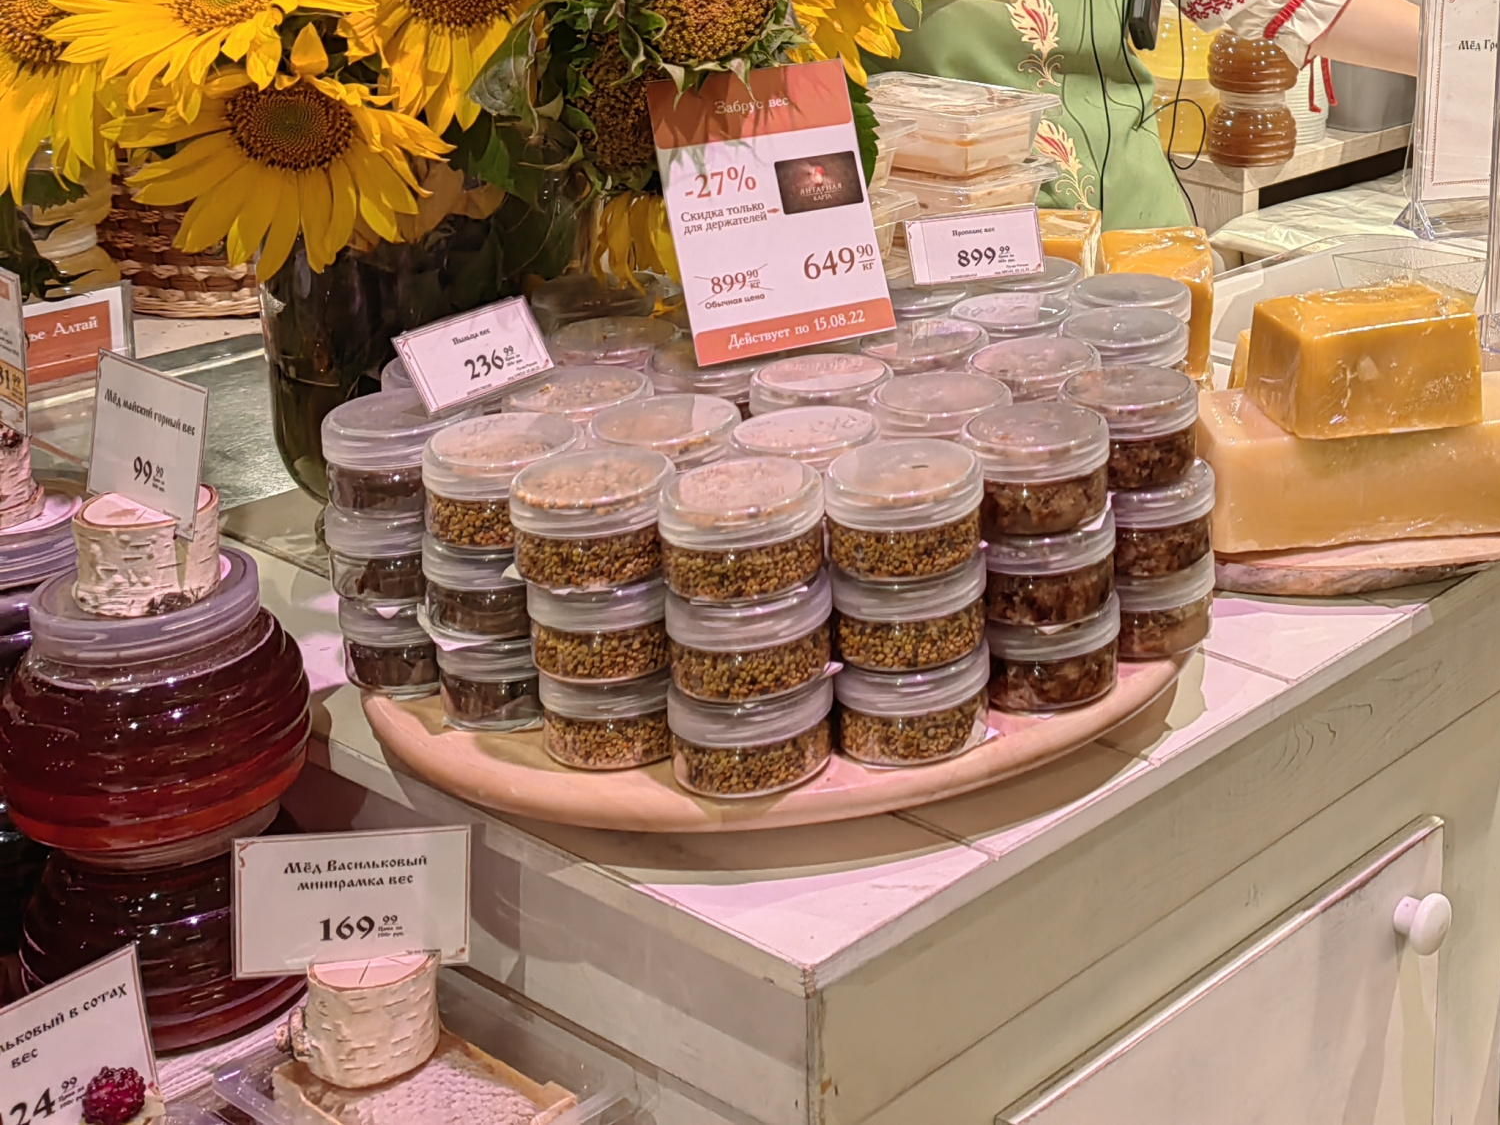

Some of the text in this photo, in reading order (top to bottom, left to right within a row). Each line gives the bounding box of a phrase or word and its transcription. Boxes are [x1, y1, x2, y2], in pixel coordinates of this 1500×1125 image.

[1458, 40, 1481, 51] Мёд
[714, 96, 789, 115] Забрус вес
[685, 165, 757, 200] -27%
[801, 183, 842, 196] ЯНТАРНАЯ
[681, 203, 765, 223] Скидка только
[684, 212, 768, 235] для держателей
[804, 244, 874, 280] 649 90
[862, 262, 874, 271] кг
[957, 245, 1010, 267] 899 99
[710, 269, 759, 295] 899 90
[705, 293, 765, 310] Обычная цена
[53, 316, 99, 337] Алтай
[728, 310, 865, 350] Действует по 15.08.22
[452, 331, 479, 345] Пыльца
[464, 345, 514, 380] 236 99
[105, 389, 195, 436] Мёд майский горный вес
[133, 456, 152, 485] 99
[284, 855, 427, 874] Мёд Васильковый
[297, 874, 414, 892] минирамка вес
[320, 915, 398, 941] 169 99
[69, 1007, 79, 1019] в
[83, 983, 127, 1011] сотах
[11, 1048, 39, 1069] вес
[0, 1077, 78, 1125] 24 99
